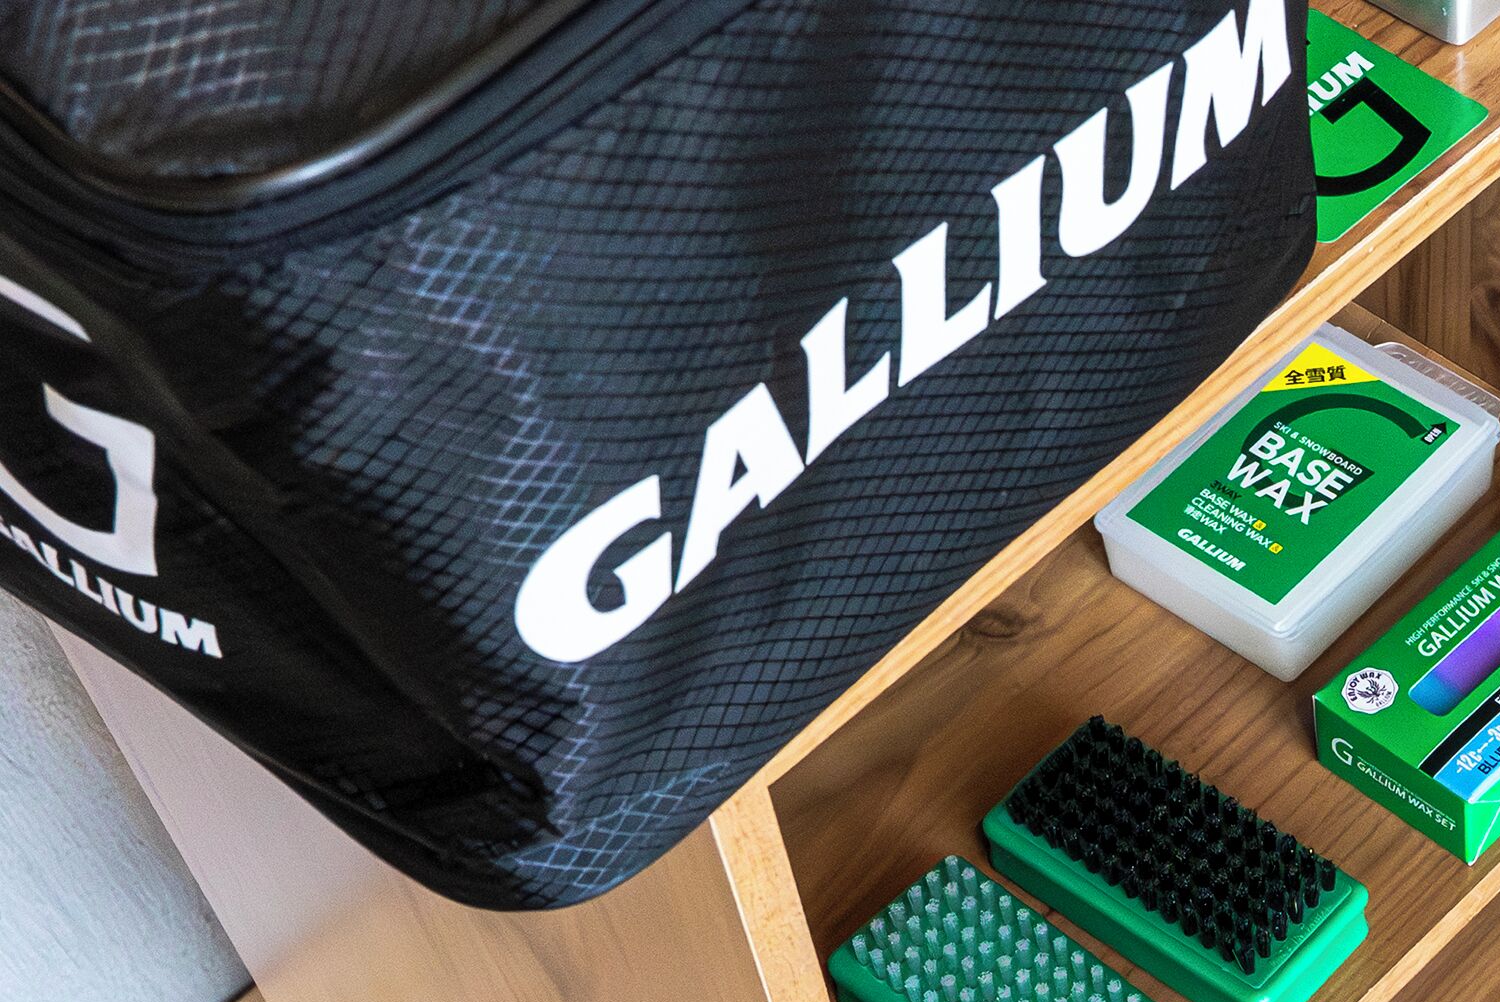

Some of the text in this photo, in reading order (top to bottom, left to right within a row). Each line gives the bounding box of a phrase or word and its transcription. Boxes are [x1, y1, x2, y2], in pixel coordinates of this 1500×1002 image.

[513, 0, 1292, 665] GALLIUM
[1284, 364, 1347, 386] 全雪質
[1249, 430, 1354, 500] BASE
[1274, 421, 1363, 476] SKI & SNOWBOARD
[1199, 488, 1231, 510] BASE
[1230, 504, 1258, 525] WAX
[1210, 479, 1242, 500] 3WAY
[1227, 453, 1328, 525] WAX
[1177, 528, 1247, 572] GALLIUM
[1191, 497, 1246, 532] CLEANING
[1245, 527, 1273, 549] WAX
[0, 515, 223, 659] ALLIUM
[1405, 627, 1425, 646] HIGH
[1423, 584, 1473, 631] PERFORMANCE
[1471, 574, 1485, 588] SKI
[1483, 570, 1490, 578] &
[1417, 587, 1496, 657] GALLIUM
[1348, 672, 1381, 702] ENJOY WAX
[1331, 737, 1354, 766] G
[1356, 761, 1457, 831] GALLIUM WAX SET
